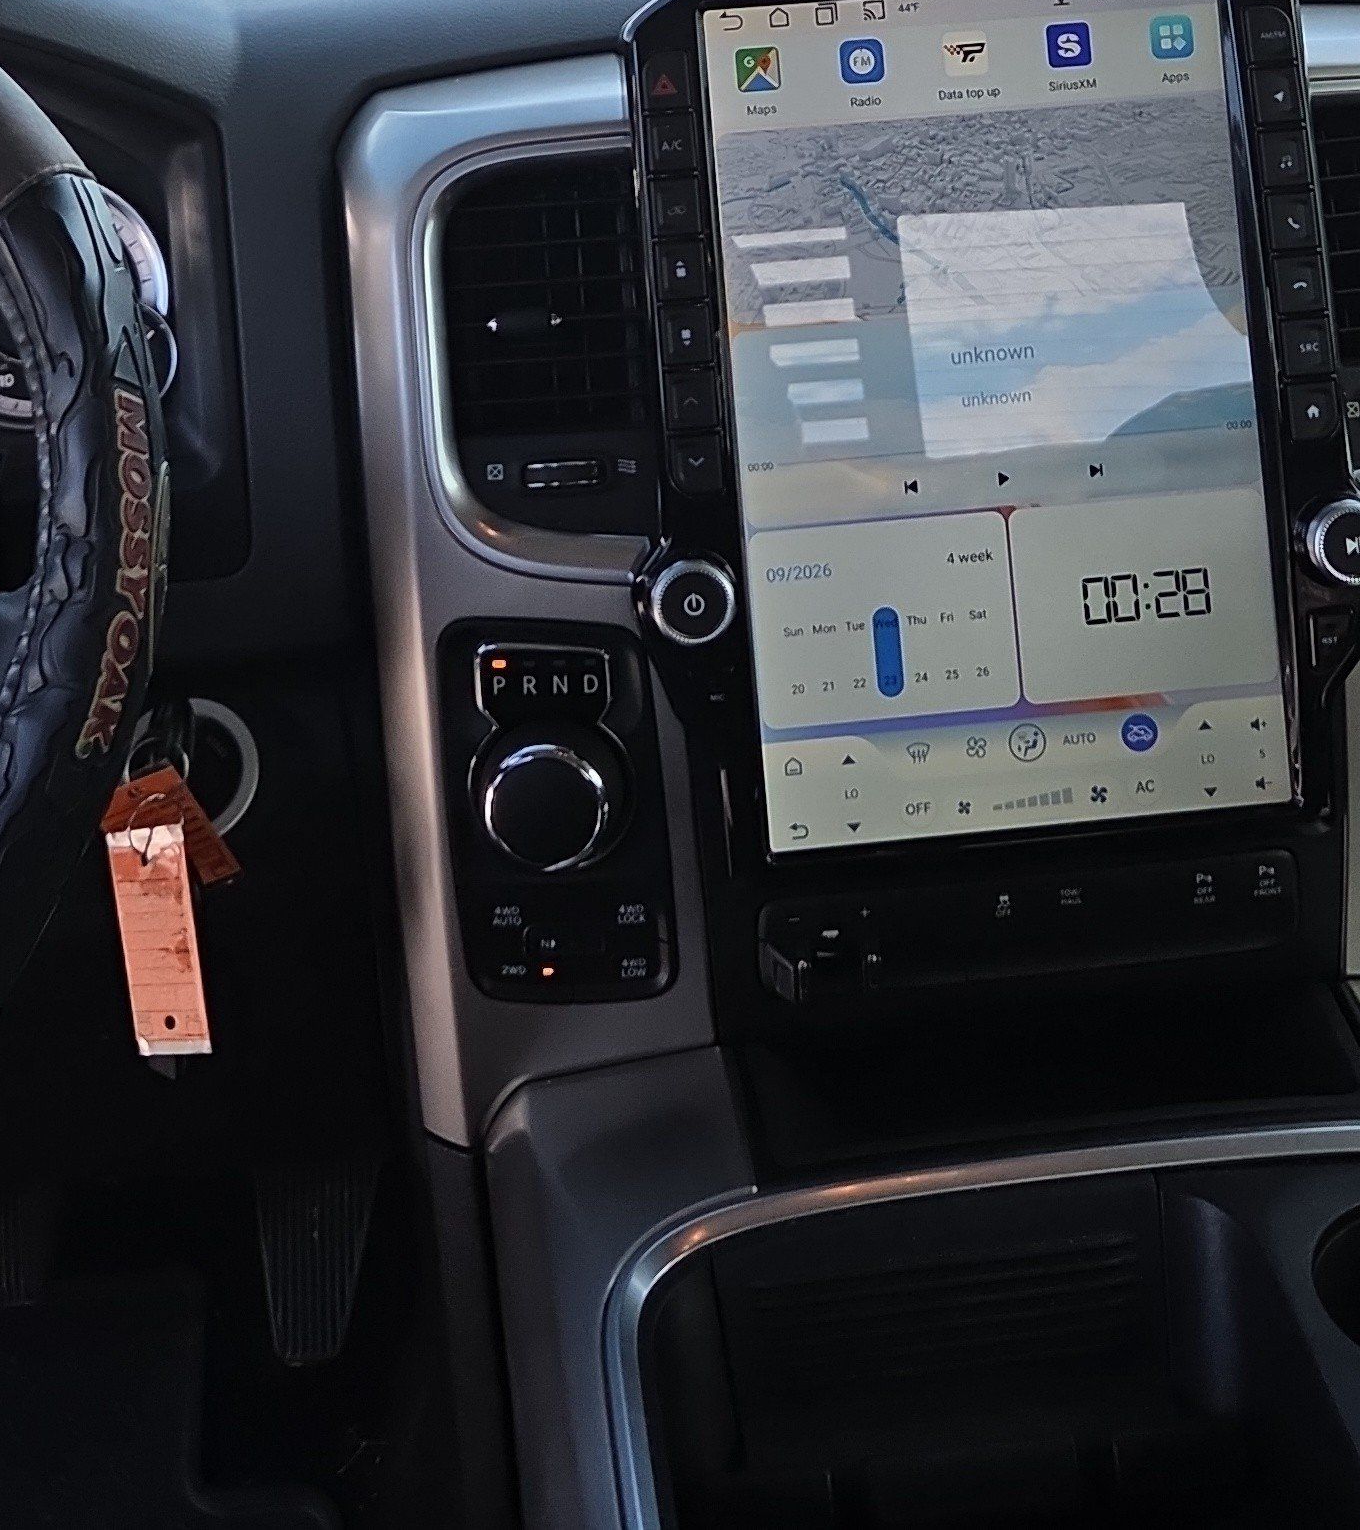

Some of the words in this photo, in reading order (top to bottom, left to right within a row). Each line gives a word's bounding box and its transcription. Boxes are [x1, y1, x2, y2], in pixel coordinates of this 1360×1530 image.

[852, 55, 872, 68] FM
[1048, 77, 1098, 93] SiriusXM
[1161, 71, 1191, 85] Apps
[938, 89, 963, 101] Data
[966, 87, 985, 101] top
[987, 87, 1001, 99] up
[850, 96, 882, 108] Radio
[746, 104, 778, 117] Maps
[661, 139, 682, 151] A/C
[950, 342, 1036, 365] unknown
[1299, 341, 1320, 353] SRC
[961, 389, 1033, 409] unknown
[114, 387, 153, 620] MOSSY
[946, 552, 955, 564] 4
[957, 548, 994, 564] week
[766, 563, 833, 584] 09/2026
[1081, 567, 1213, 627] 00:28
[783, 627, 804, 638] Sun
[812, 624, 837, 635] Mon
[845, 621, 866, 632] Tue
[906, 615, 927, 626] Thu
[940, 612, 955, 623] Fri
[968, 609, 987, 621] Sat
[75, 610, 139, 760] OAK
[492, 676, 506, 695] P
[523, 675, 538, 695] R
[552, 674, 569, 695] N
[583, 674, 599, 694] D
[791, 683, 805, 695] 20
[822, 681, 835, 692] 21
[853, 678, 867, 689] 22
[915, 672, 929, 683] 24
[945, 670, 960, 680] 25
[976, 666, 990, 677] 26
[1063, 732, 1097, 746] AUTO
[1201, 753, 1216, 765] LO
[1135, 779, 1155, 794] AC
[844, 788, 859, 800] LO
[905, 802, 932, 816] OFF
[494, 905, 521, 916] 4WD
[618, 903, 645, 914] 4WD
[492, 916, 523, 926] AUTO
[621, 956, 647, 968] 4WD
